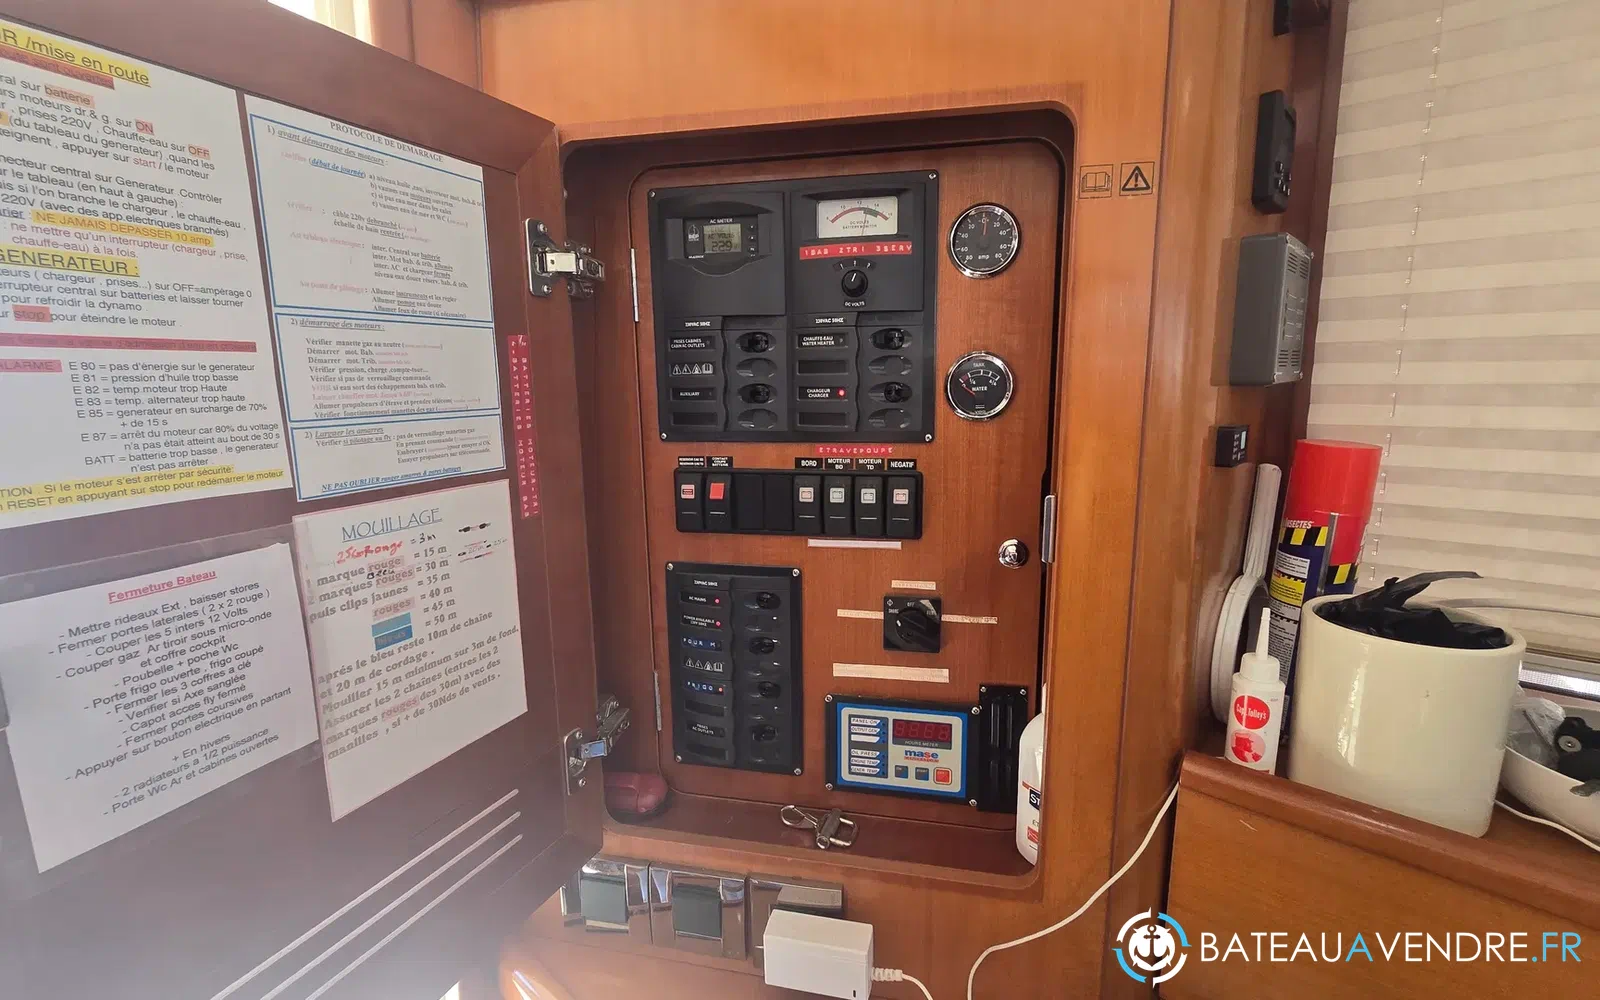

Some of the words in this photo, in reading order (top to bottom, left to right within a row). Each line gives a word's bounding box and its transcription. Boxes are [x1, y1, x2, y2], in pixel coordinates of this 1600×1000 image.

[82, 57, 103, 71] en
[108, 65, 149, 85] route
[21, 80, 40, 92] sur
[45, 84, 91, 105] batterie
[20, 92, 71, 113] moteurs
[116, 116, 132, 128] sur
[136, 121, 154, 133] ON
[19, 105, 57, 123] prises
[60, 115, 92, 130] 220V
[103, 125, 168, 149] Chauffe-eau
[170, 142, 186, 152] sur
[188, 144, 209, 157] OFF
[34, 121, 81, 139] tableau
[84, 132, 98, 144] du
[101, 137, 163, 161] generateur)
[330, 121, 383, 144] PROTOCOLE
[385, 139, 395, 147] DE
[396, 142, 444, 163] DEMARRAGE
[62, 139, 109, 159] appuyer
[113, 149, 129, 162] sur
[133, 155, 156, 169] start
[344, 147, 356, 156] des
[51, 162, 91, 182] central
[115, 176, 174, 195] Generateur
[35, 211, 56, 224] NE
[59, 214, 106, 230] JAMAIS
[110, 223, 173, 240] DEPASSER
[176, 233, 188, 243] 10
[712, 241, 732, 251] 229
[69, 362, 78, 371] E
[80, 362, 96, 371] 80
[109, 363, 129, 373] pas
[209, 362, 255, 373] generateur
[71, 374, 79, 382] E
[83, 374, 96, 382] 81
[111, 374, 156, 384] pression
[158, 373, 190, 382] d'huile
[84, 455, 115, 466] BATT
[7, 496, 52, 510] RESET
[321, 484, 332, 492] NE
[334, 481, 348, 490] PAS
[341, 508, 441, 541] MOUILLAGE
[317, 567, 365, 588] marque
[367, 559, 401, 573] rouge
[423, 546, 435, 558] 15
[437, 545, 447, 554] m
[319, 580, 373, 603] marques
[376, 569, 413, 588] rouges
[425, 561, 436, 571] 30
[439, 559, 449, 568] m
[108, 579, 174, 603] Fermeture
[177, 569, 216, 587] Bateau
[427, 588, 440, 599] 40
[68, 619, 111, 639] Mettre
[115, 608, 159, 629] rideaux
[162, 602, 180, 614] Ext
[189, 591, 227, 608] baisser
[230, 581, 259, 596] stores
[309, 606, 337, 624] puis
[339, 592, 369, 612] clips
[371, 585, 409, 606] jaunes
[58, 635, 107, 654] Fermer
[110, 624, 149, 642] portes
[151, 608, 199, 629] laterales
[95, 637, 141, 656] Couper
[174, 619, 205, 634] inters
[208, 614, 221, 624] 12
[223, 606, 248, 620] Volts
[371, 649, 394, 663] bleu
[398, 637, 425, 653] reste
[427, 629, 449, 643] 10m
[450, 624, 461, 634] de
[464, 611, 493, 628] chaîne
[155, 647, 187, 664] coffre
[189, 635, 226, 654] cockpit
[386, 650, 428, 673] cordage
[122, 662, 174, 687] Poubelle
[187, 649, 220, 667] poche
[322, 688, 373, 715] Mouiller
[404, 655, 452, 680] minimum
[687, 682, 713, 690] FRIGO
[74, 751, 128, 779] Appuyer
[153, 728, 192, 748] bouton
[133, 762, 190, 793] radiateurs
[221, 728, 269, 754] puissance
[904, 749, 939, 759] mase
